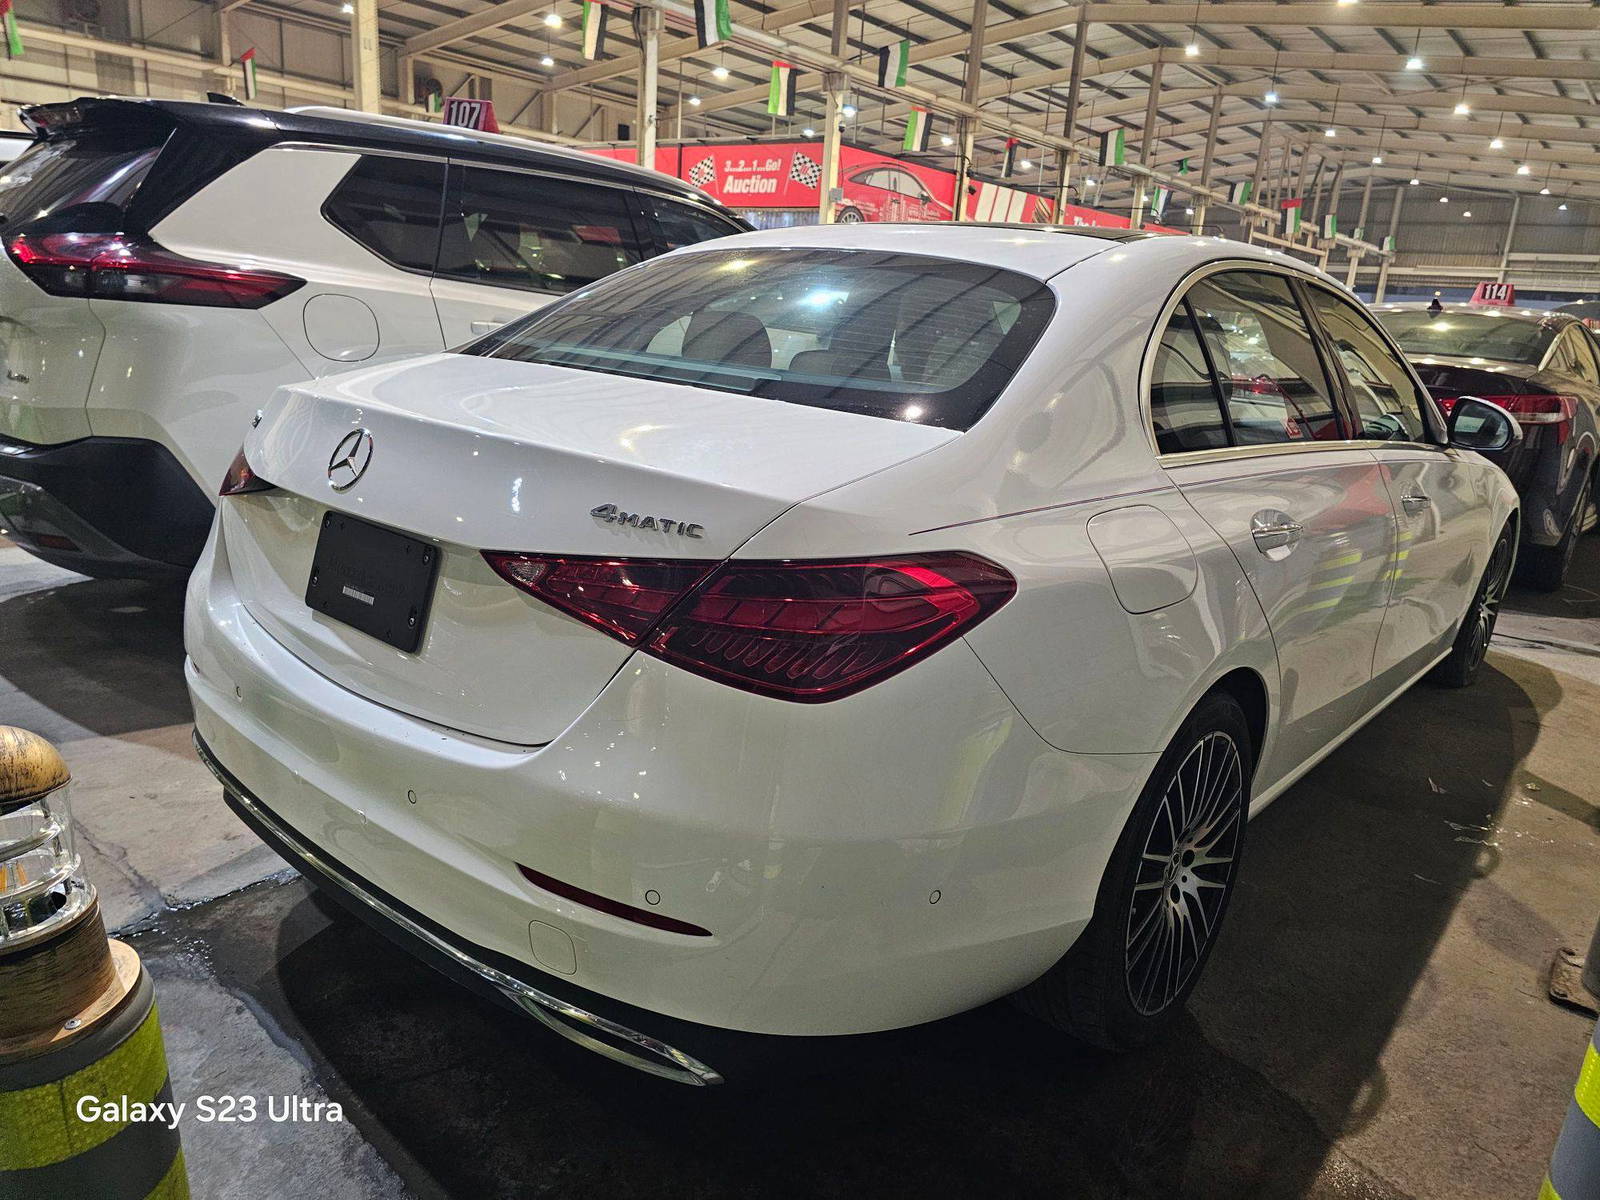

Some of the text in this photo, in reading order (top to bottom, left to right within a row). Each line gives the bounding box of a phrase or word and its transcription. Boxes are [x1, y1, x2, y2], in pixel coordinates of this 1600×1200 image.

[450, 100, 481, 129] 107
[722, 175, 778, 194] Auction
[1484, 284, 1507, 300] 114
[590, 503, 705, 539] 4MATIC
